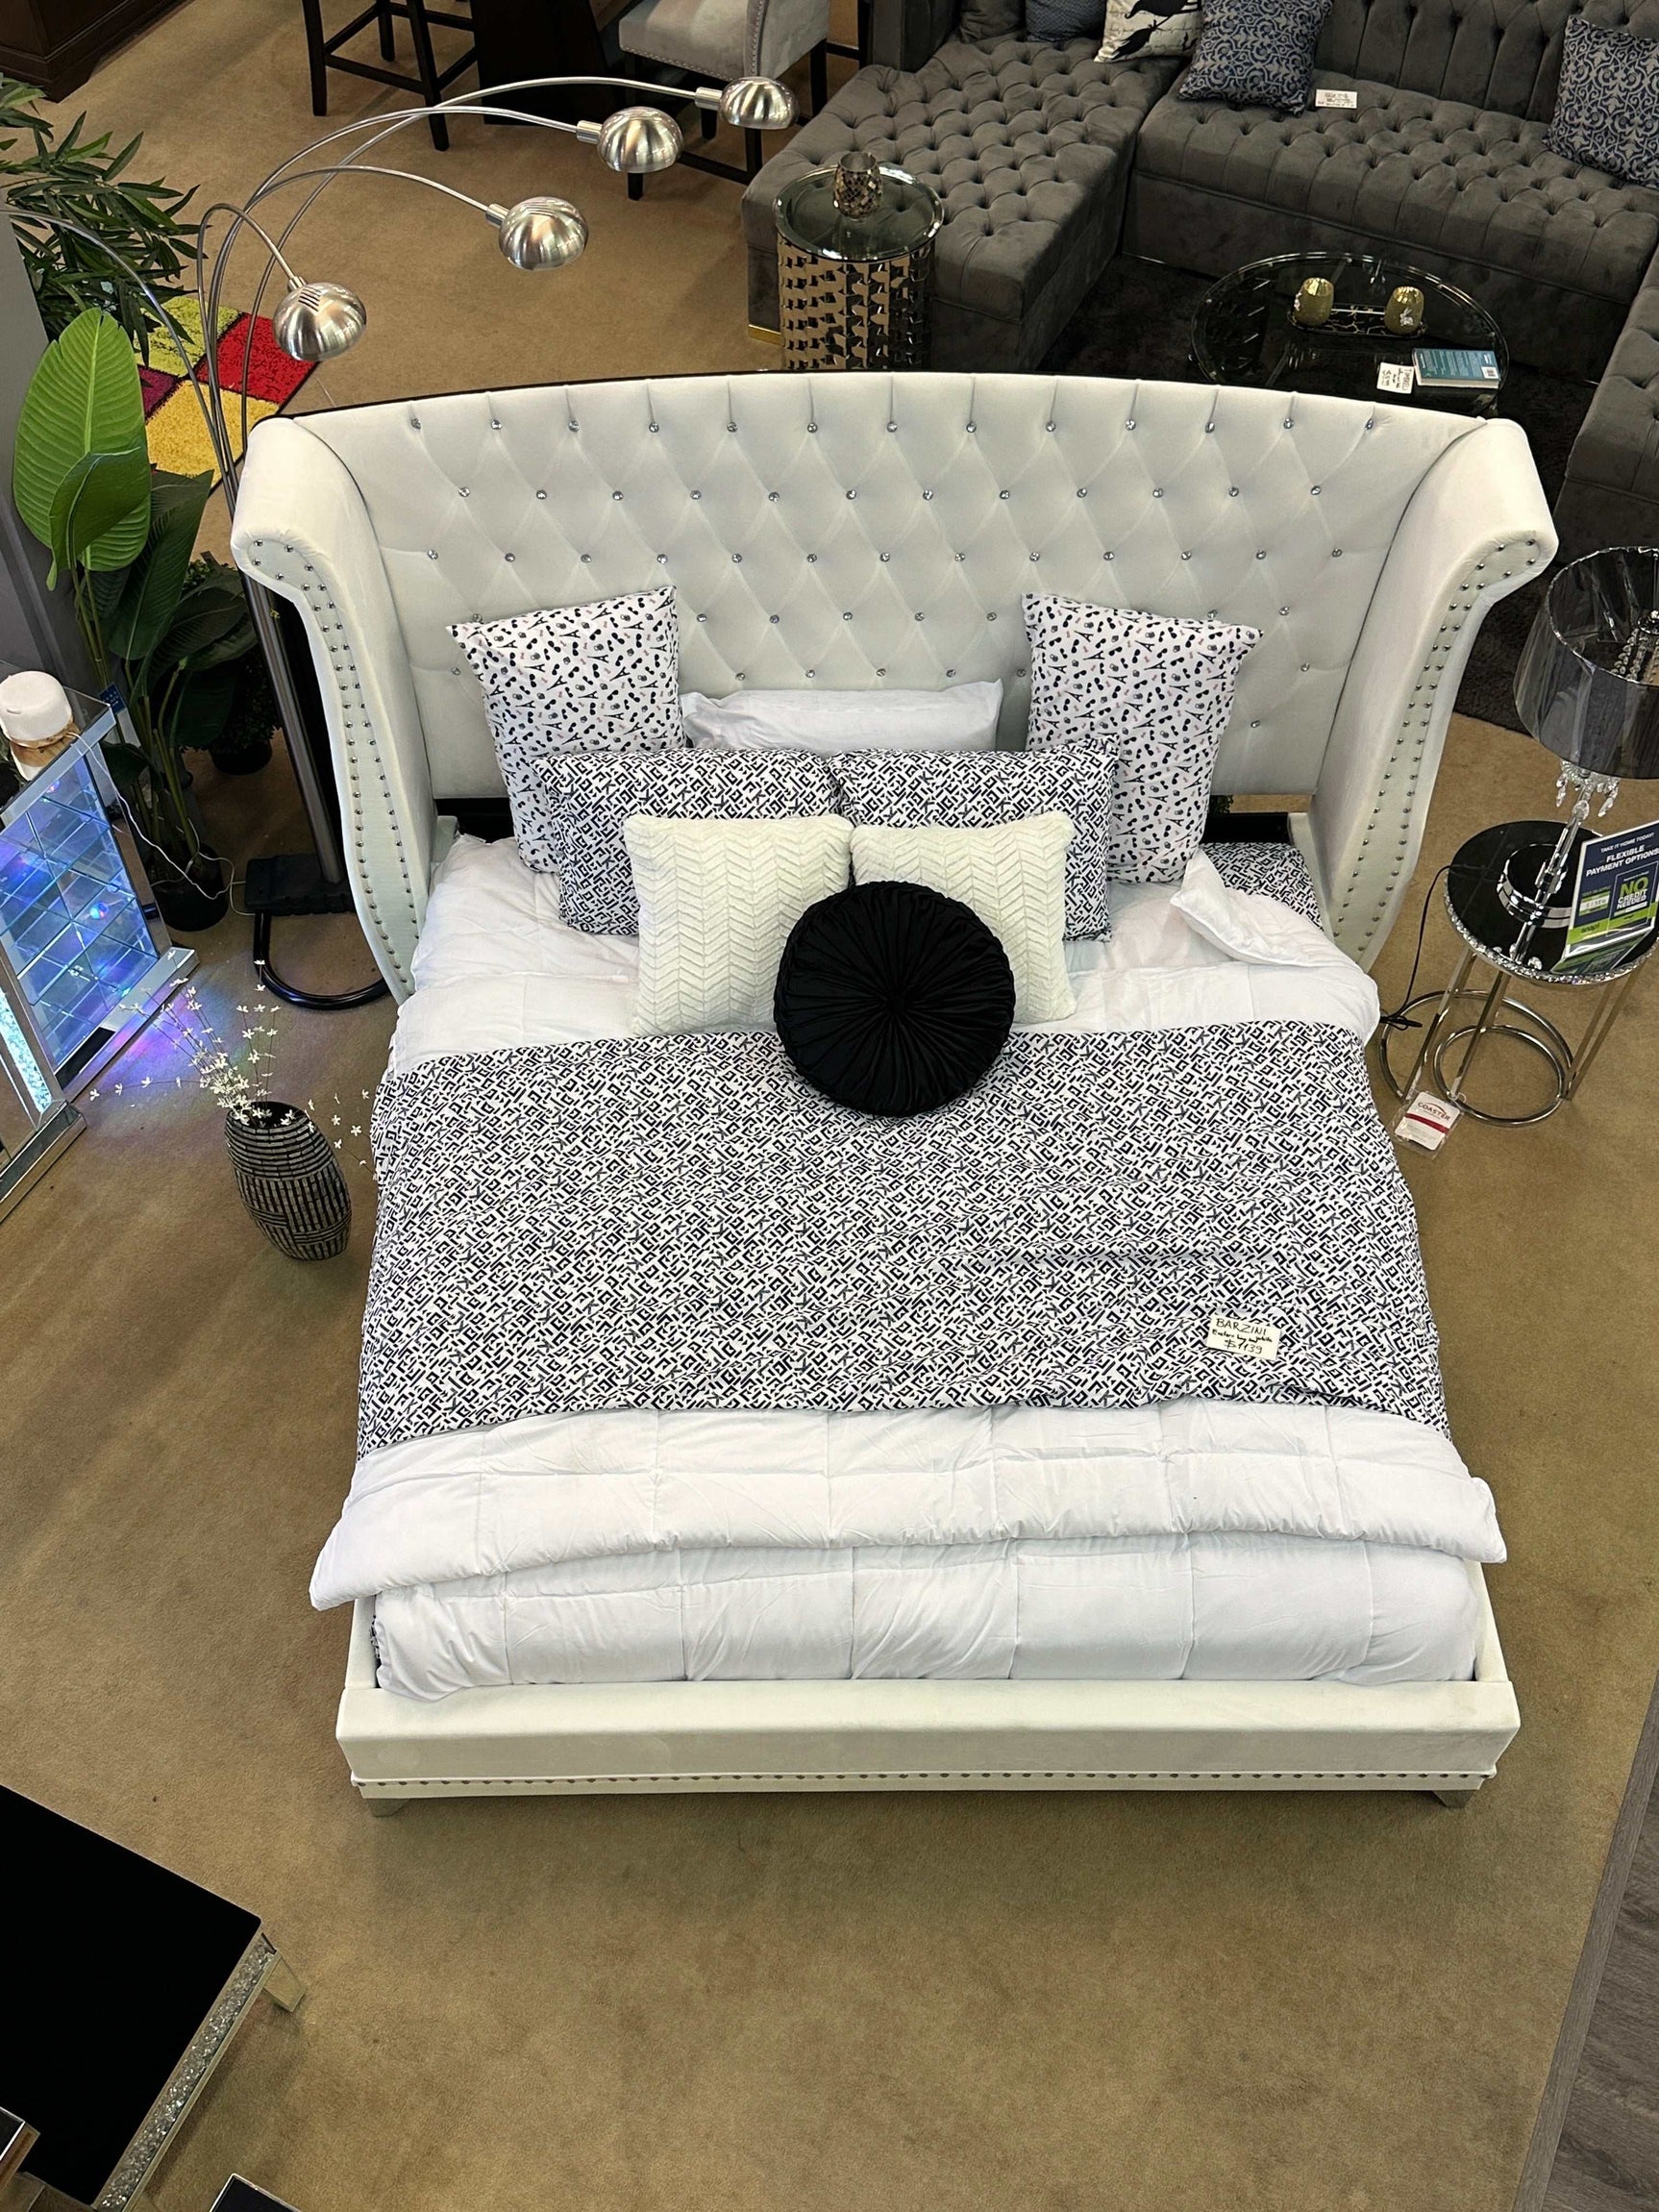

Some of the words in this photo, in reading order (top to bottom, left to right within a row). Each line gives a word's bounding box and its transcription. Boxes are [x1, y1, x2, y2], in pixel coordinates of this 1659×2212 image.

[1606, 845, 1646, 863] FLEXIBLE
[1586, 859, 1624, 877] PAYMENT
[1620, 876, 1649, 897] NO
[1616, 895, 1647, 909] NEEDED
[1618, 888, 1648, 904] CREDIT
[1417, 1102, 1451, 1121] COASTER
[1216, 1318, 1267, 1335] BARZINI
